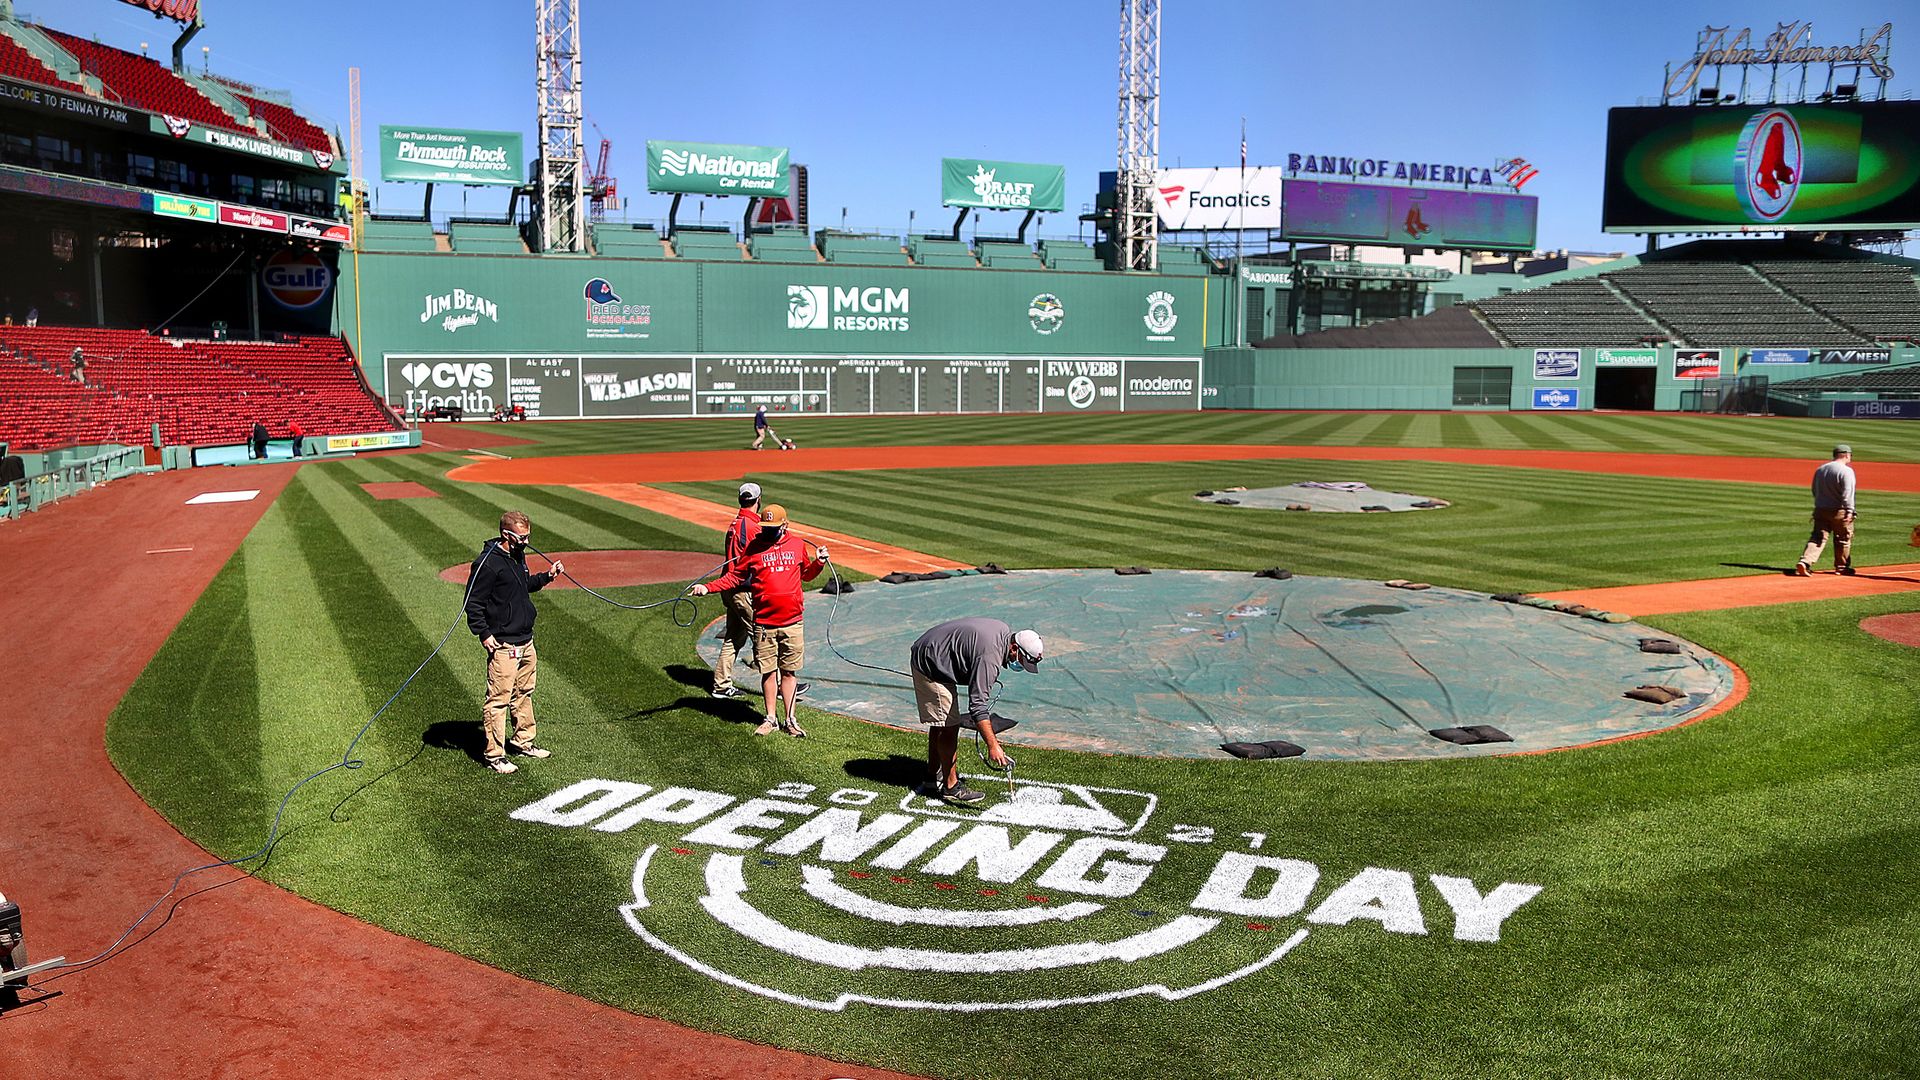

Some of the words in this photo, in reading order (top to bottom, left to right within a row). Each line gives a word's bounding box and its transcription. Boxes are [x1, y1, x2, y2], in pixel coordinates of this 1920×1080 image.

[1665, 25, 1759, 98] John
[1758, 20, 1895, 80] Hancock
[0, 83, 41, 104] ELCOME
[44, 93, 57, 107] TO
[60, 99, 100, 118] FENWAY
[103, 107, 128, 123] PARK
[218, 134, 248, 150] BLACK
[249, 142, 272, 156] LIVES
[273, 146, 304, 163] MATTER
[398, 141, 468, 161] Plymouth
[469, 145, 506, 162] Rock
[687, 153, 780, 178] National
[1288, 153, 1353, 176] BANK
[1360, 158, 1389, 177] OF
[1394, 162, 1493, 186] AMERICA
[720, 177, 739, 188] Car
[740, 179, 775, 189] Rental
[974, 180, 1034, 196] DRAFT
[982, 194, 1031, 207] KINGS
[1189, 191, 1271, 208] Fanatics
[266, 265, 326, 288] Gulf
[420, 294, 452, 324] JIM
[453, 288, 499, 323] BEAM
[592, 305, 620, 314] RED
[623, 305, 651, 315] SOX
[833, 286, 910, 314] MGM
[833, 316, 910, 332] RESORTS
[1856, 352, 1889, 361] NESN
[431, 362, 494, 388] CVS
[405, 389, 496, 415] Health
[1540, 395, 1570, 403] IRVING
[1853, 403, 1901, 416] jetBlue
[766, 512, 773, 521] B
[510, 778, 1167, 899] OPENING
[1191, 850, 1543, 943] DAY
